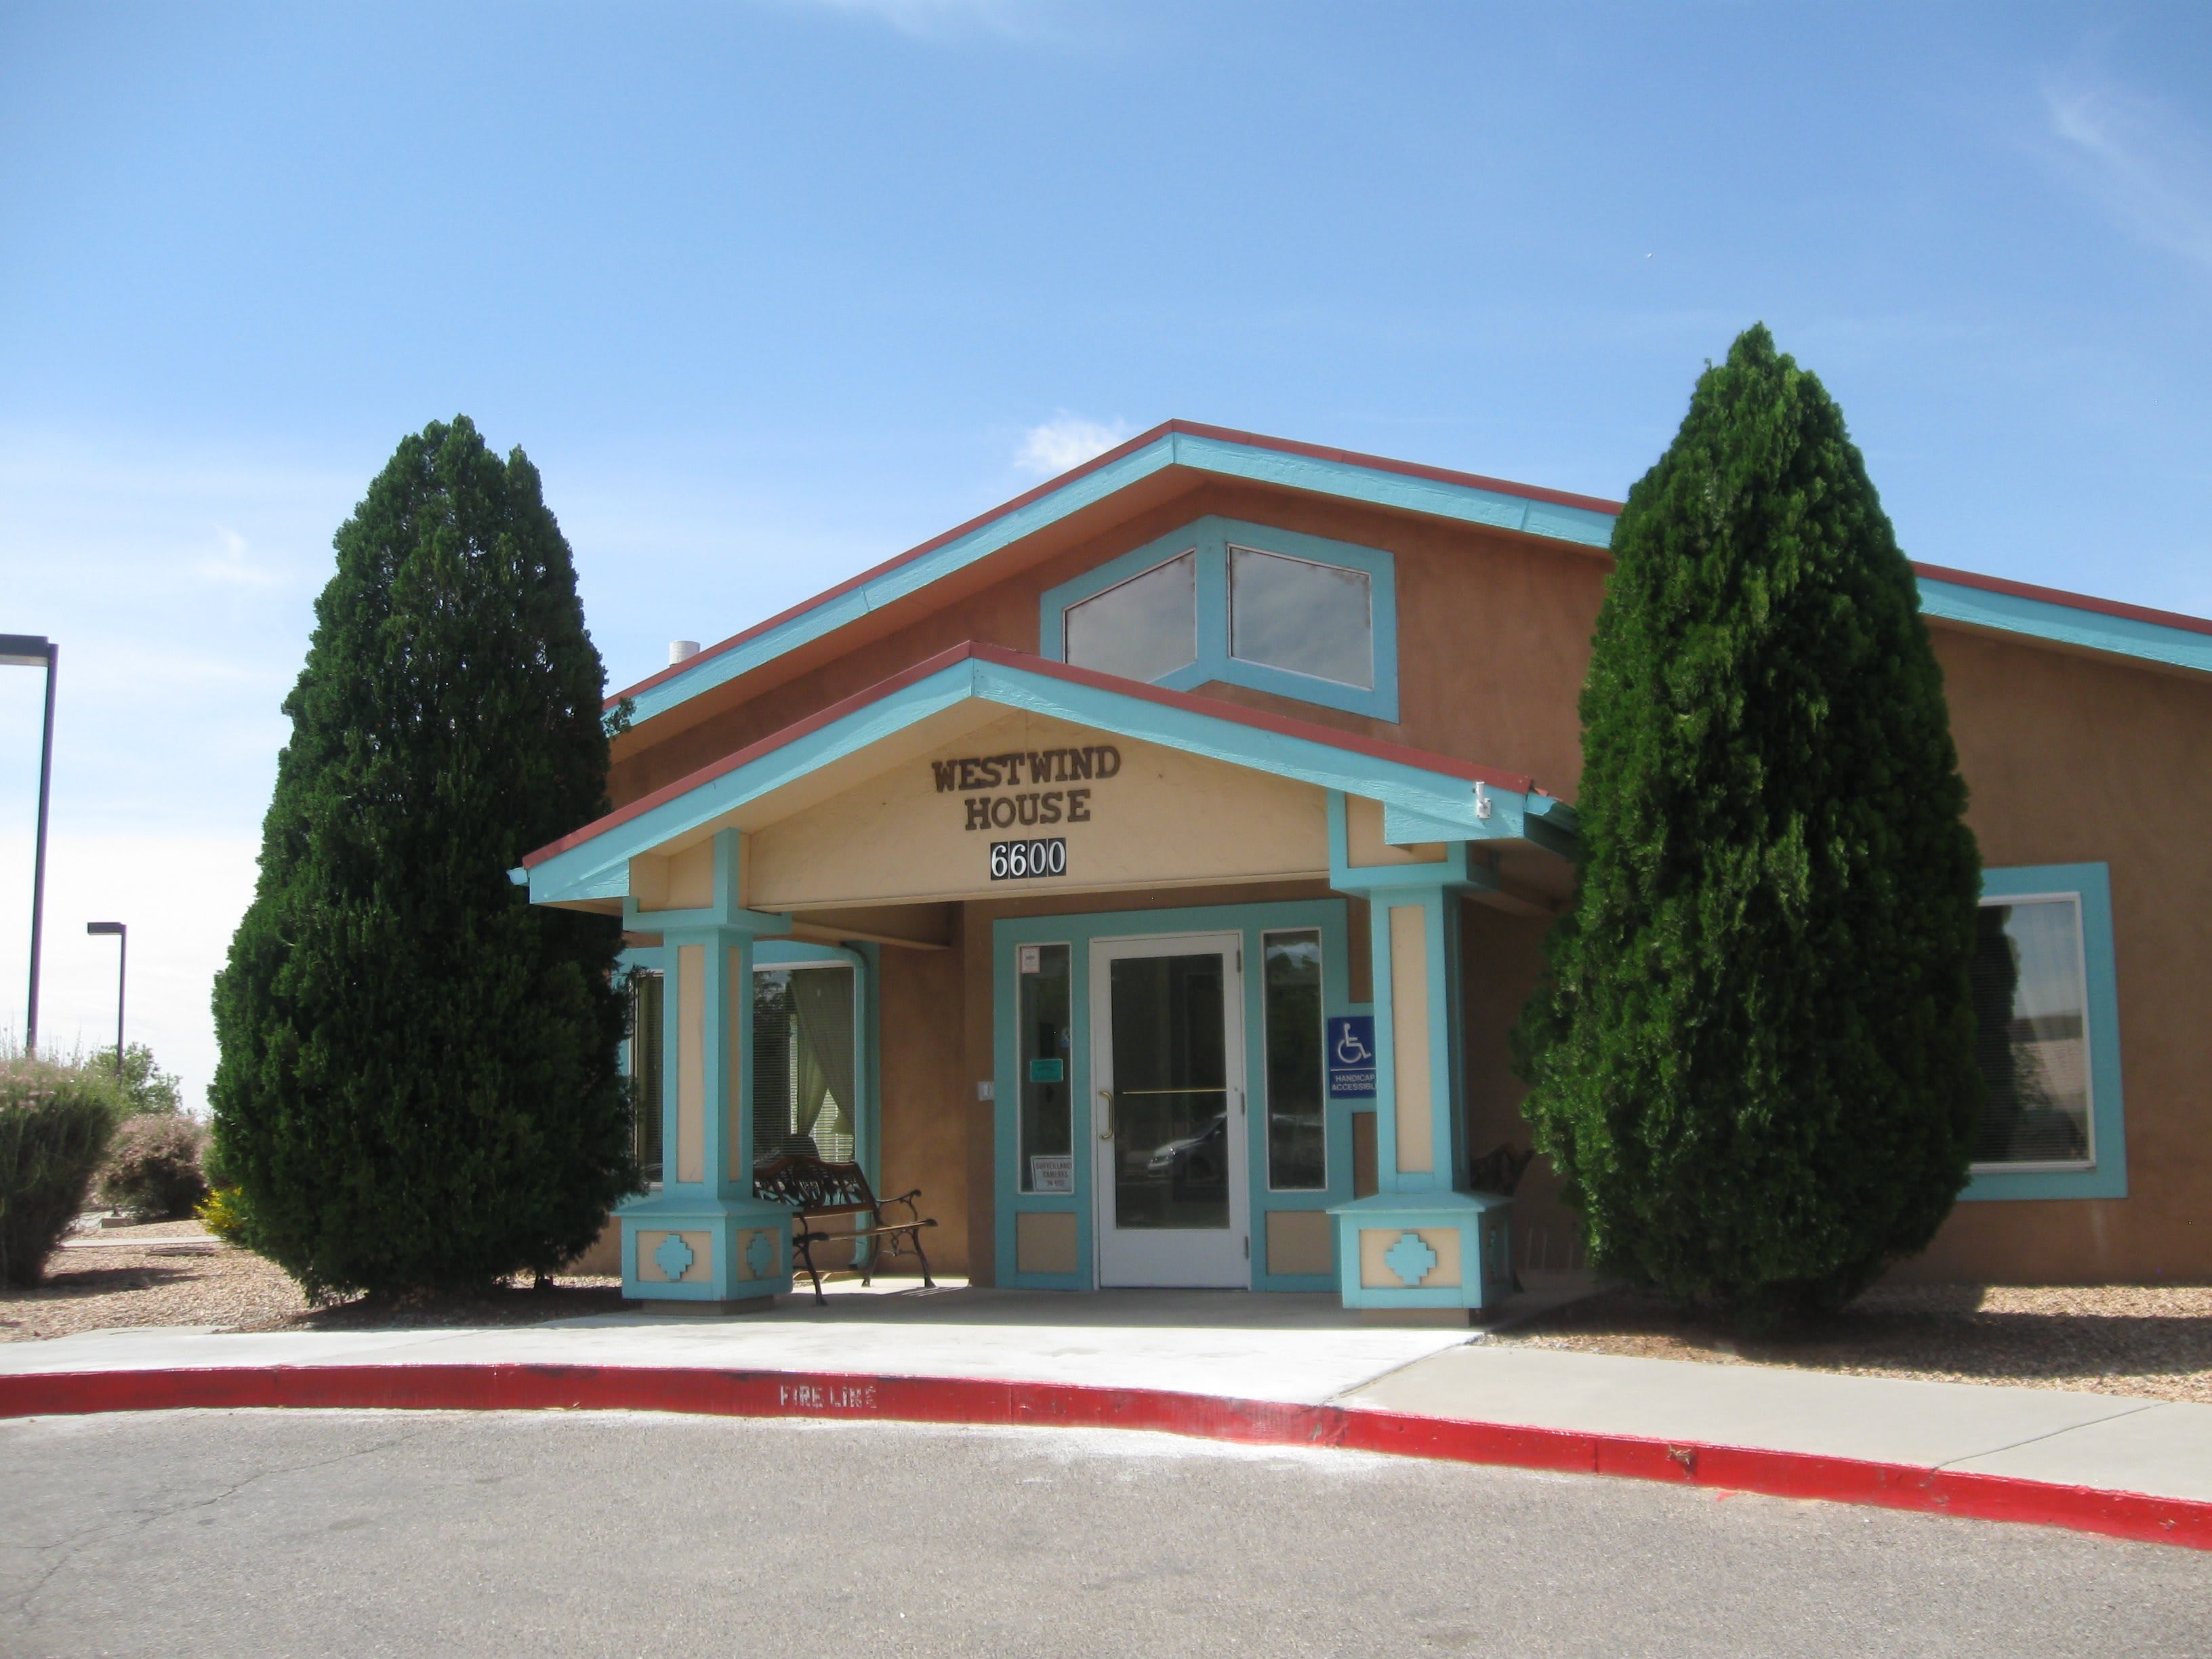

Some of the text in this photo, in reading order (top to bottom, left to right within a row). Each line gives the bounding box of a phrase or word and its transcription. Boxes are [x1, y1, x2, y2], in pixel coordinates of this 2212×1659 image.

[931, 745, 1122, 793] WESTWIND
[964, 789, 1090, 831] HOUSE
[991, 840, 1066, 878] 6600
[1335, 1074, 1375, 1082] HANDICAP
[780, 1385, 824, 1408] FIRE
